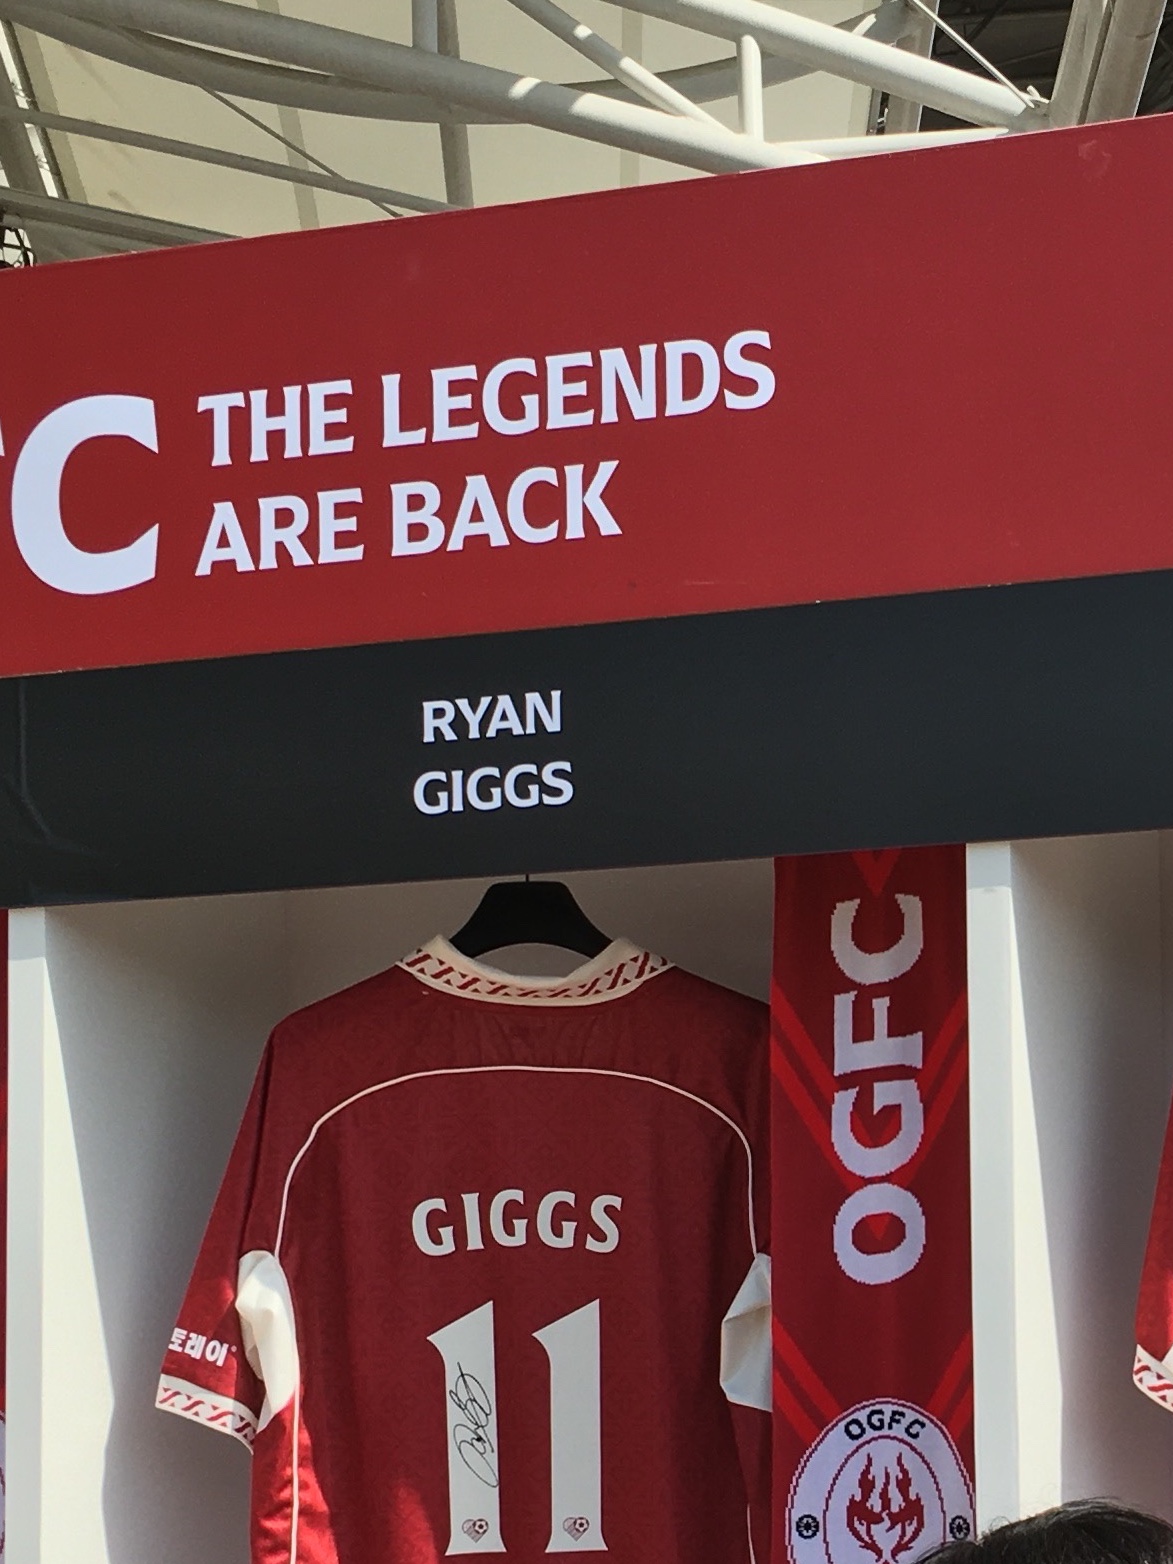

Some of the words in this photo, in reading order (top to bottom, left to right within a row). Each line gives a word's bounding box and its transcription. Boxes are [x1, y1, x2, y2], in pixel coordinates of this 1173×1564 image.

[197, 379, 354, 467] THE
[382, 331, 777, 448] LEGENDS
[195, 487, 365, 577] ARE
[391, 460, 623, 557] BACK
[421, 690, 563, 744] RYAN
[413, 762, 574, 815] GIGGS
[831, 893, 926, 1285] OGFC
[411, 1188, 623, 1256] GIGGS
[426, 1298, 609, 1556] 11
[844, 1409, 926, 1440] OGFC
